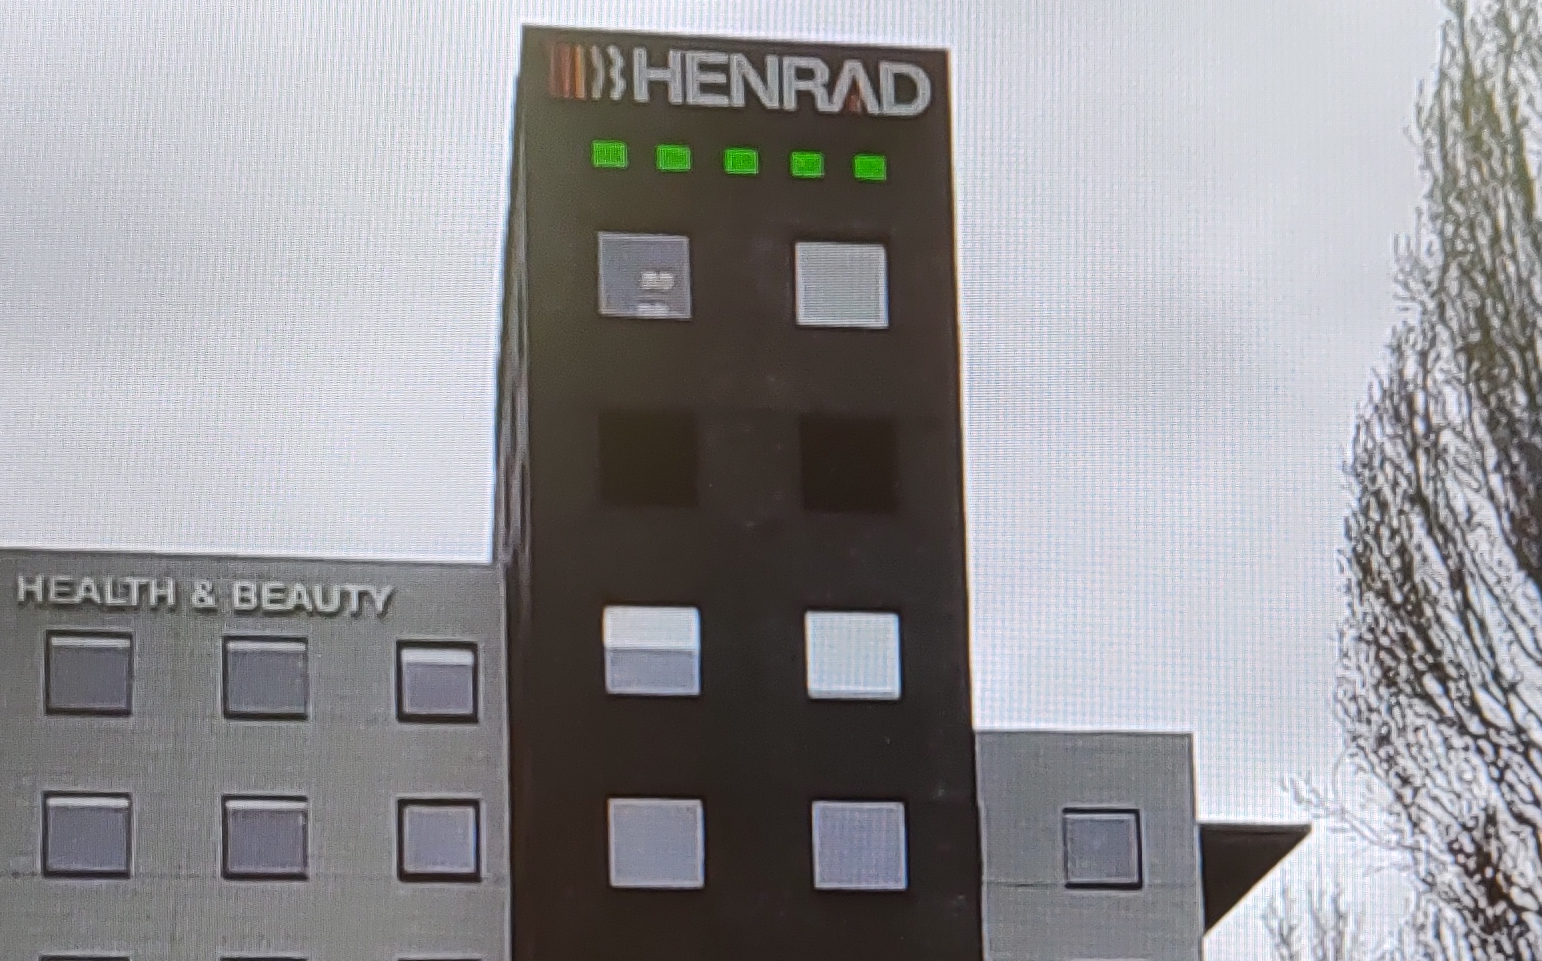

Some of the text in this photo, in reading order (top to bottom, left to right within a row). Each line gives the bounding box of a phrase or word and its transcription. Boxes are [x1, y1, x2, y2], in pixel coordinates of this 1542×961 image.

[633, 45, 932, 117] HENRAD
[17, 573, 394, 618] HEALTH & BEAUTY
